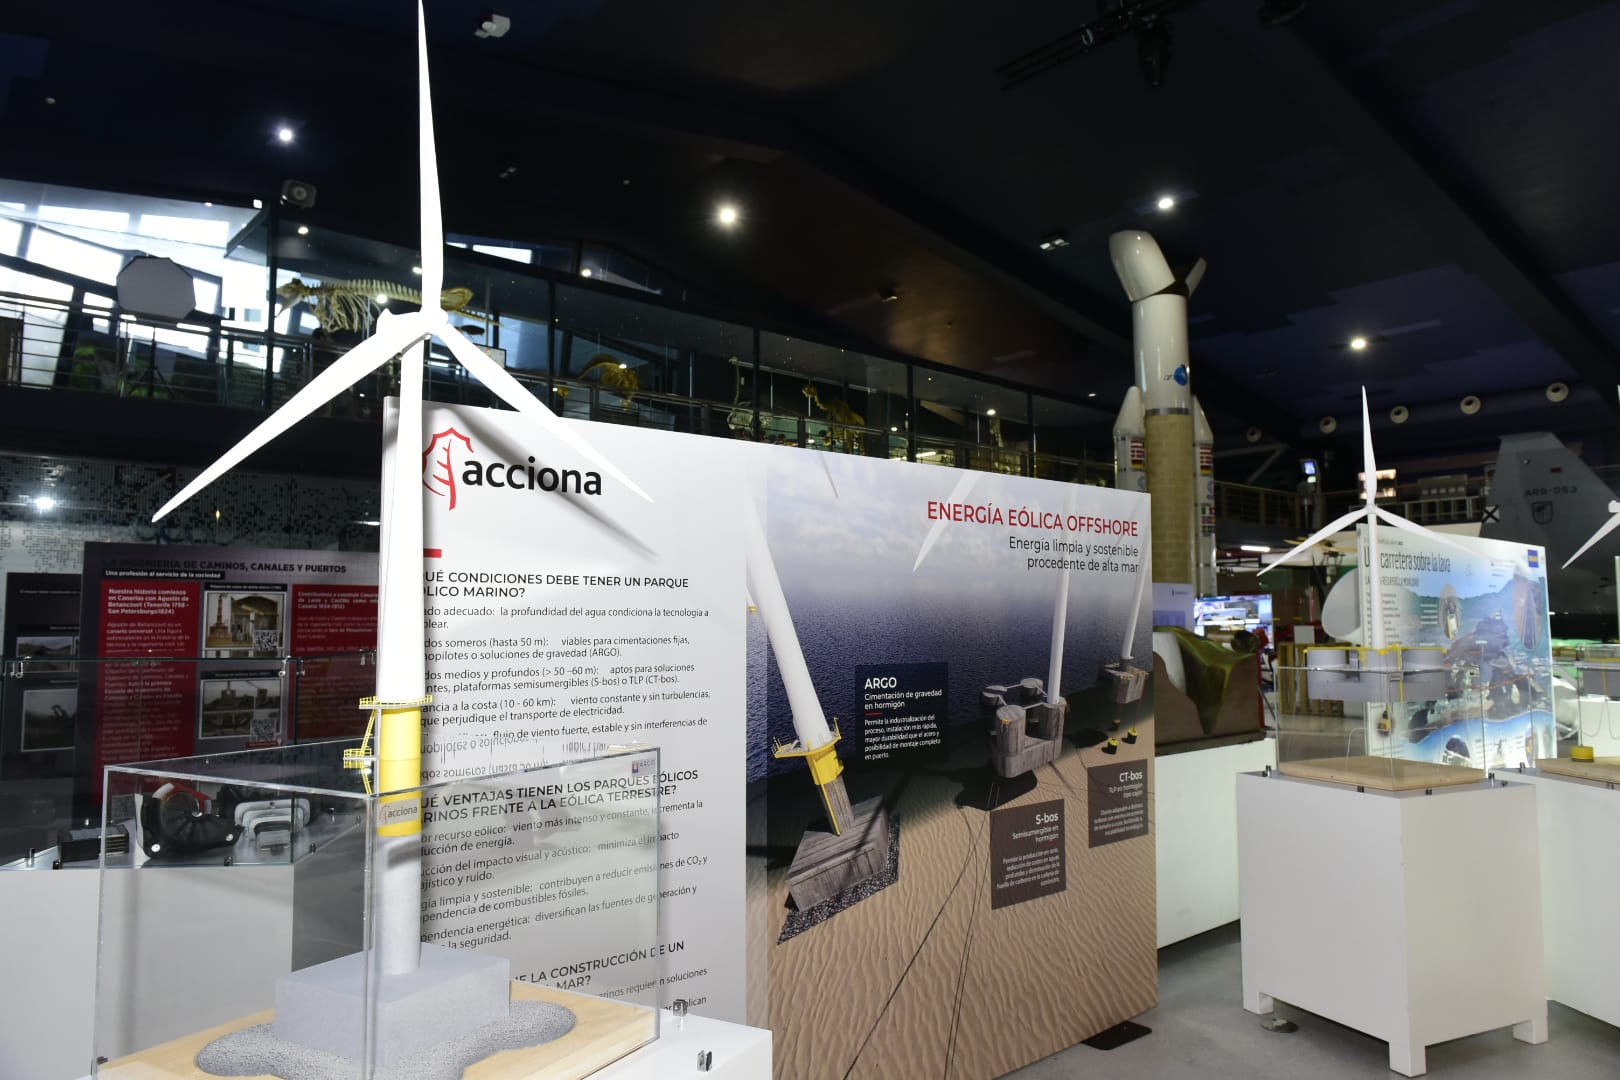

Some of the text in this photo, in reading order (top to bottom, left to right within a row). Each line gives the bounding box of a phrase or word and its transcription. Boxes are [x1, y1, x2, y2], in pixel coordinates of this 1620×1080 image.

[462, 456, 602, 496] acciona
[927, 501, 1138, 536] ENERGÍA EÓLICA OFFSHORE
[1009, 536, 1138, 557] Energía limpia y sostenible
[251, 563, 294, 572] CANALES
[306, 565, 346, 573] PUERTOS
[1028, 557, 1138, 572] procedente de alta mar
[1380, 552, 1412, 569] carretera
[1414, 552, 1430, 571] sobre
[449, 572, 688, 588] CONDICIONES DEBE TENER UN PARQUE
[464, 587, 525, 597] MARINO?
[444, 607, 494, 615] adecuado:
[501, 606, 508, 616] la
[511, 606, 567, 618] profundidad
[570, 608, 582, 616] del
[585, 609, 606, 618] agua
[608, 608, 652, 616] condiciona
[655, 608, 661, 616] la
[490, 638, 518, 648] (hasta
[521, 638, 532, 646] 50
[534, 638, 548, 647] m):
[562, 637, 591, 646] viables
[594, 638, 611, 646] para
[614, 636, 671, 644] cimentaciones
[674, 636, 689, 646] fijas,
[480, 648, 621, 660] soluciones de gravedad (ARGO).
[445, 664, 694, 679] medios profundos 50 m): aptos para soluciones
[454, 675, 679, 694] plataformas semisumergibles (S-bos) TLP (CT-bos).
[864, 677, 897, 689] ARGO
[461, 701, 469, 710] la
[472, 701, 497, 710] costa
[500, 699, 514, 710] (10
[523, 699, 534, 708] 60
[536, 697, 556, 706] km):
[571, 695, 598, 704] viento
[601, 694, 640, 704] constante
[649, 692, 659, 700] sin
[865, 692, 904, 700] Cimentación
[915, 689, 942, 699] gravedad
[875, 701, 905, 709] hormigón
[442, 714, 496, 726] perjudique
[500, 712, 508, 720] el
[510, 709, 557, 720] transporte
[560, 708, 570, 717] de
[573, 706, 624, 717] electricidad.
[516, 717, 708, 738] de viento fuerte, estable sin interferencias de
[1120, 771, 1142, 782] CT-bos
[443, 789, 512, 806] VENTAJAS
[516, 784, 562, 798] TIENEN
[568, 782, 590, 792] LOS
[594, 776, 649, 790] PARQUES
[388, 806, 417, 818] acciona
[472, 802, 524, 817] FRENTE
[528, 801, 536, 811] A
[540, 799, 556, 810] LA
[560, 794, 604, 807] EÓLICA
[435, 800, 703, 841] recurso eólico: viento más intenso la
[1035, 812, 1058, 824] S-bos
[461, 836, 514, 851] de energía.
[455, 851, 541, 871] del impacto visual
[440, 894, 470, 906] limpia
[482, 884, 532, 899] sostenible:
[540, 874, 594, 890] contribuyen
[602, 866, 632, 879] reducir
[676, 858, 685, 868] de
[466, 871, 494, 882] ruido.
[479, 903, 491, 912] de
[494, 892, 556, 910] combustibles
[477, 894, 645, 932] energética: diversifican las fuentes de
[460, 930, 511, 948] seguridad.
[550, 948, 647, 978] CONSTRUCCIÓN
[668, 941, 684, 953] UN
[556, 975, 591, 990] MAR?
[666, 968, 708, 984] soluciones
